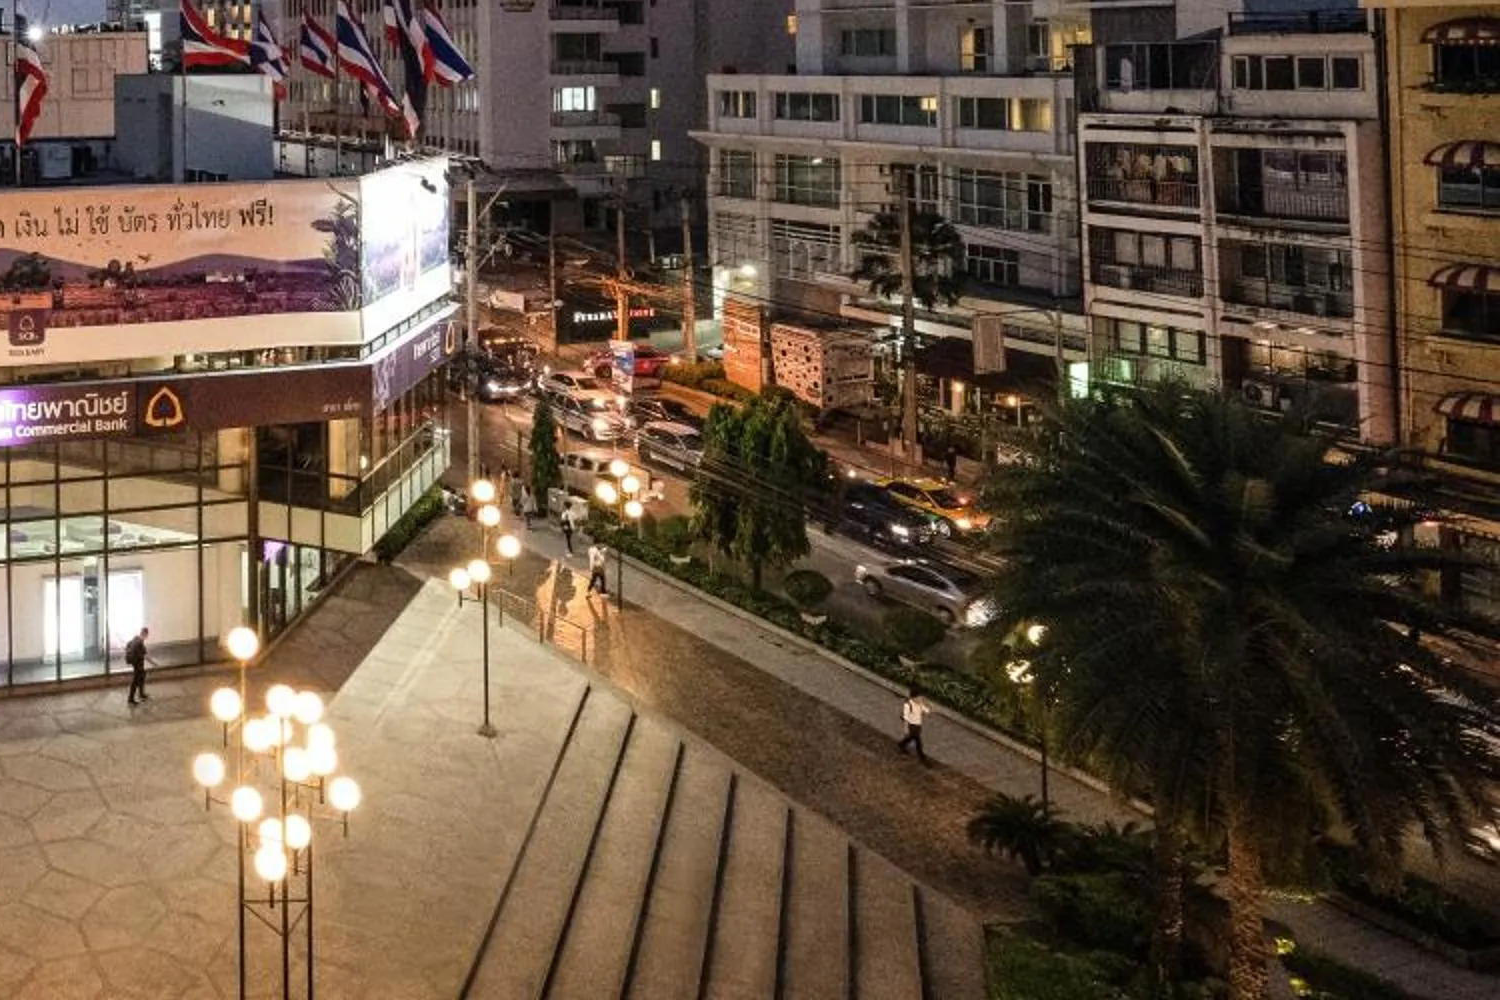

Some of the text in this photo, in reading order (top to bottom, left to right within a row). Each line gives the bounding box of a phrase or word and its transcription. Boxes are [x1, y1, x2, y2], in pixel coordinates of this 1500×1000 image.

[15, 210, 47, 237] เงิน
[55, 207, 80, 236] ไม่
[87, 205, 109, 235] ใช้
[118, 206, 157, 234] บัตร
[167, 198, 231, 232] ทั่วไทย
[240, 199, 274, 228] ฟรี!
[15, 421, 92, 437] Commercial
[95, 417, 128, 431] Bank
